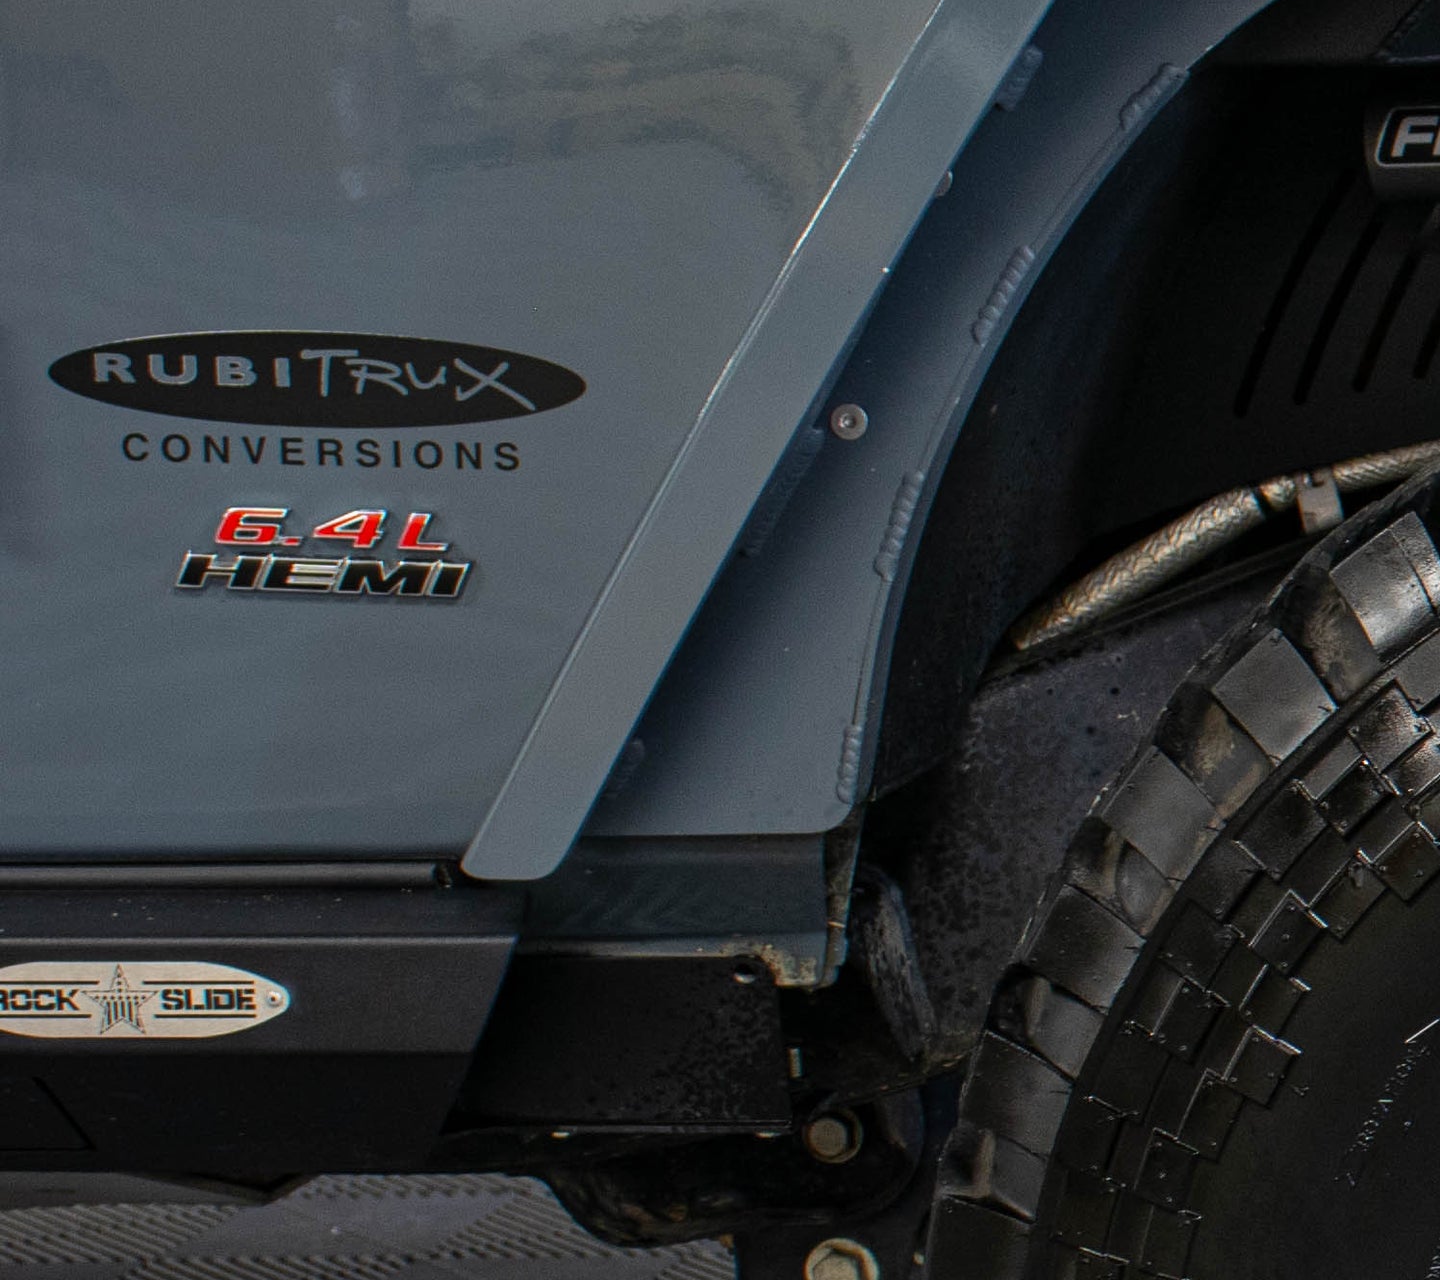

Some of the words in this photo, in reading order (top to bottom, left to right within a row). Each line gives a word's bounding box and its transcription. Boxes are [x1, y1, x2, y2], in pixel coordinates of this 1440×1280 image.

[122, 433, 520, 470] CONVERSIONS
[214, 506, 450, 552] 6.4L
[174, 550, 472, 598] HEMI
[161, 989, 257, 1011] SLIDE
